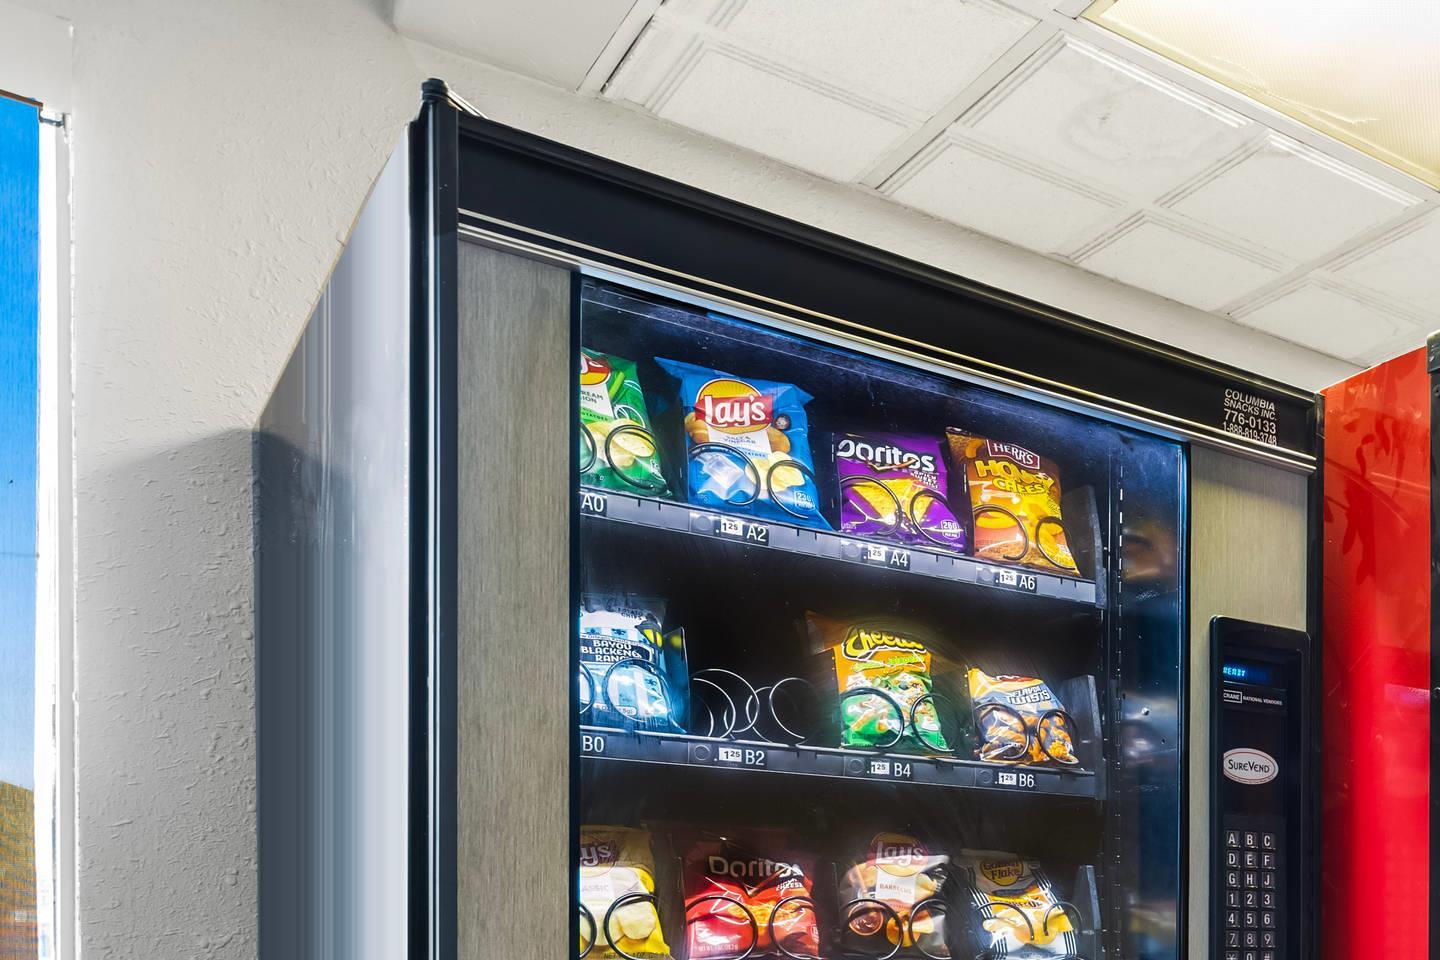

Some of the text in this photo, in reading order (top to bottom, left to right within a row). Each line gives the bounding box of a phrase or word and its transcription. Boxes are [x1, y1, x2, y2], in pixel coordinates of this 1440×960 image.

[1225, 389, 1275, 411] COLUMBIA
[704, 395, 766, 426] Lay's
[1224, 398, 1277, 421] SNACKS INC.
[1224, 408, 1276, 434] 776-0133
[836, 439, 935, 472] Doritos
[993, 442, 1034, 465] HERR'S
[992, 475, 1045, 494] CHEES
[582, 494, 605, 513] A0
[746, 525, 767, 542] A2
[890, 552, 909, 567] A4
[1019, 575, 1036, 590] A6
[581, 646, 642, 658] BLACKEN
[593, 640, 632, 650] BAYOU
[596, 654, 628, 662] RAN
[582, 736, 605, 753] B0
[746, 750, 765, 766] B2
[894, 763, 911, 778] B4
[1019, 774, 1035, 788] B6
[1228, 834, 1270, 846] A B C
[876, 841, 923, 866] Lay's
[1229, 854, 1270, 866] D E F
[708, 856, 804, 878] Doritos
[1229, 873, 1270, 886] G H J
[1230, 894, 1270, 904] 1 2 3
[1228, 913, 1270, 924] 4 5 6
[1230, 934, 1271, 944] 7 8 9
